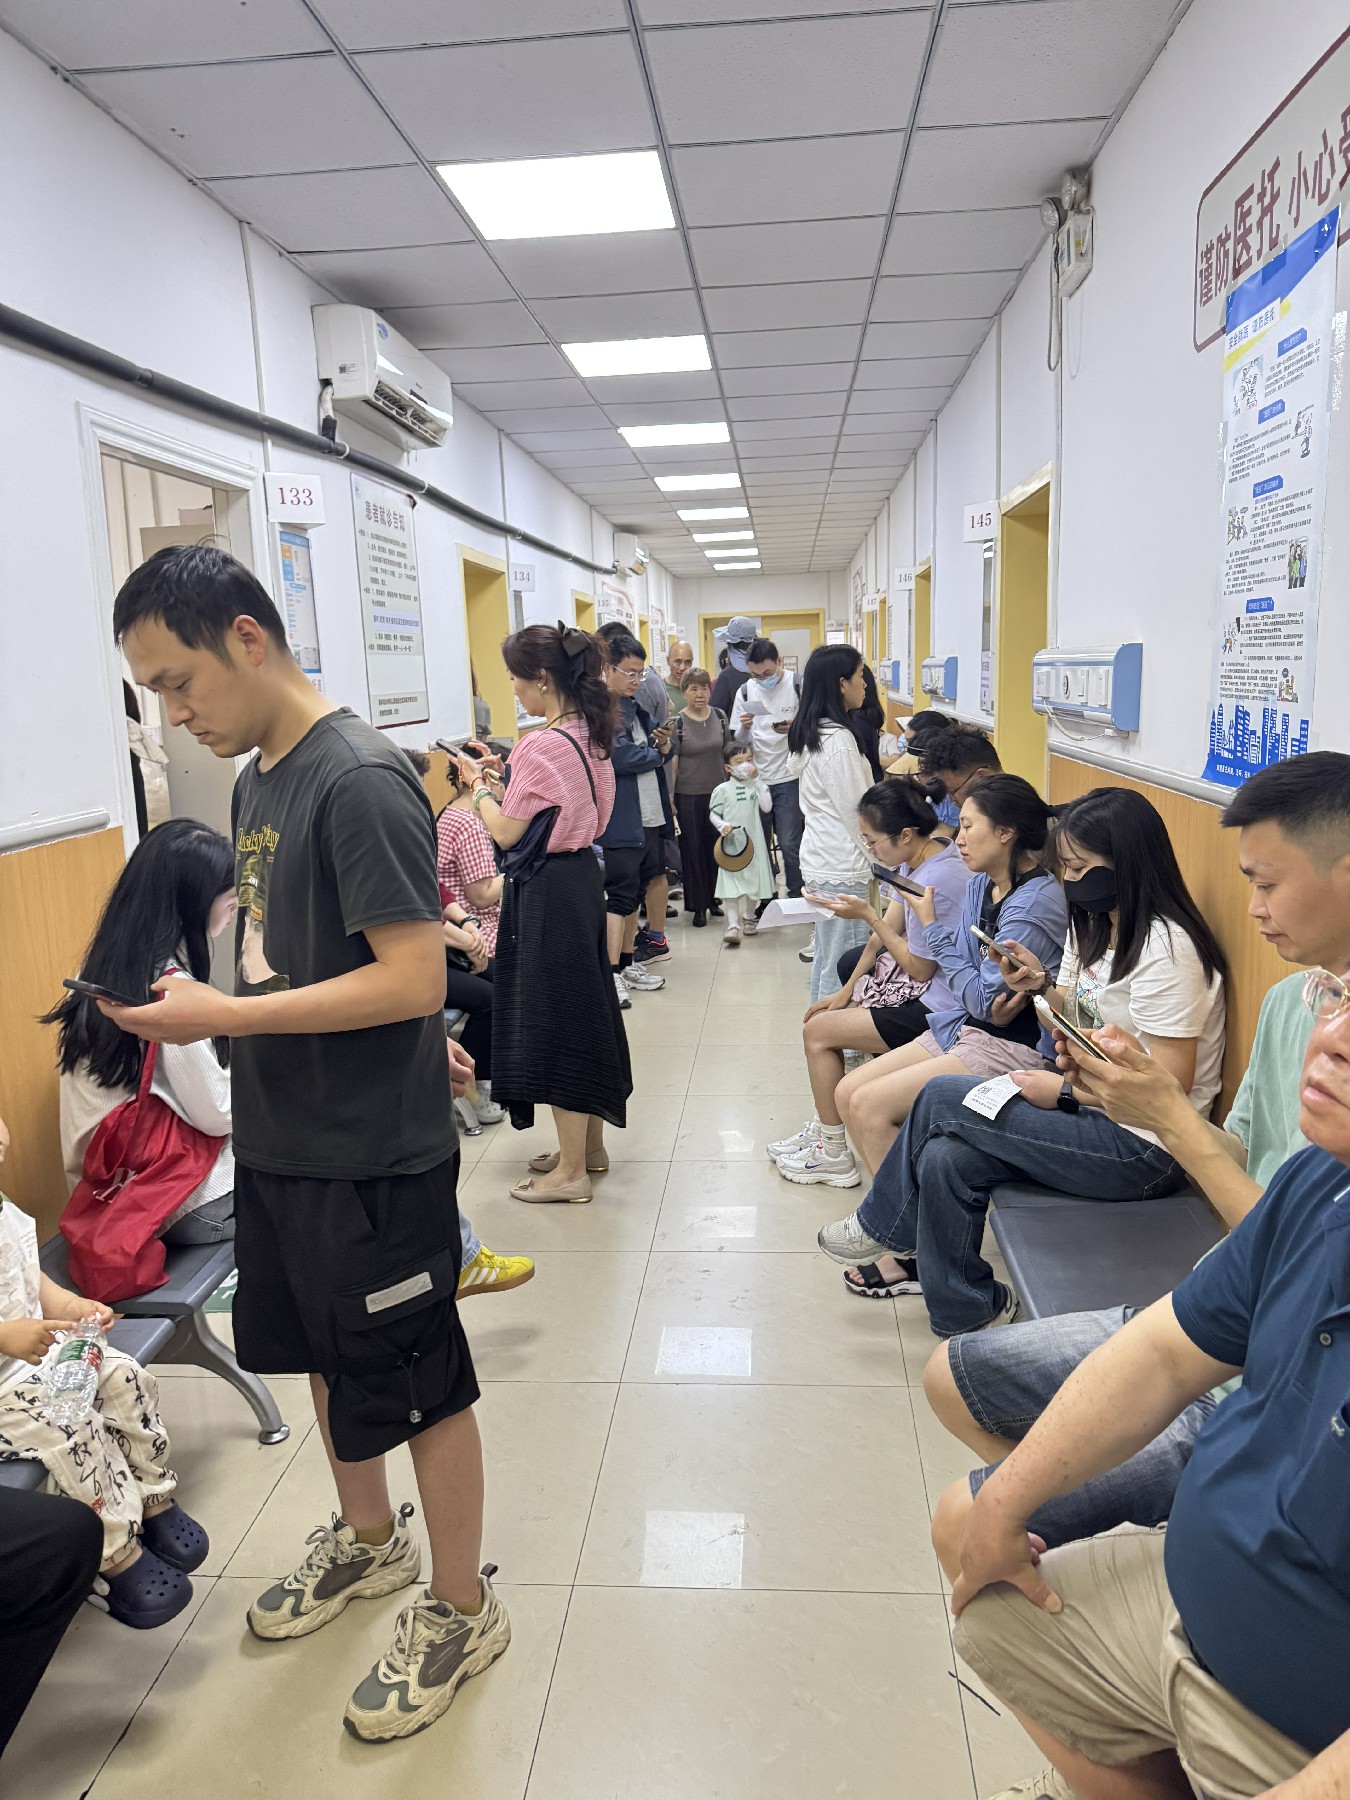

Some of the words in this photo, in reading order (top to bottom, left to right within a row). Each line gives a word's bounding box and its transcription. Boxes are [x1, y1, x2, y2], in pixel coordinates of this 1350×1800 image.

[1199, 155, 1281, 308] 谨防医托
[278, 487, 314, 506] 133
[365, 501, 406, 532] 患者就诊告知
[970, 512, 992, 529] 145
[514, 571, 530, 582] 134
[899, 573, 913, 583] 146
